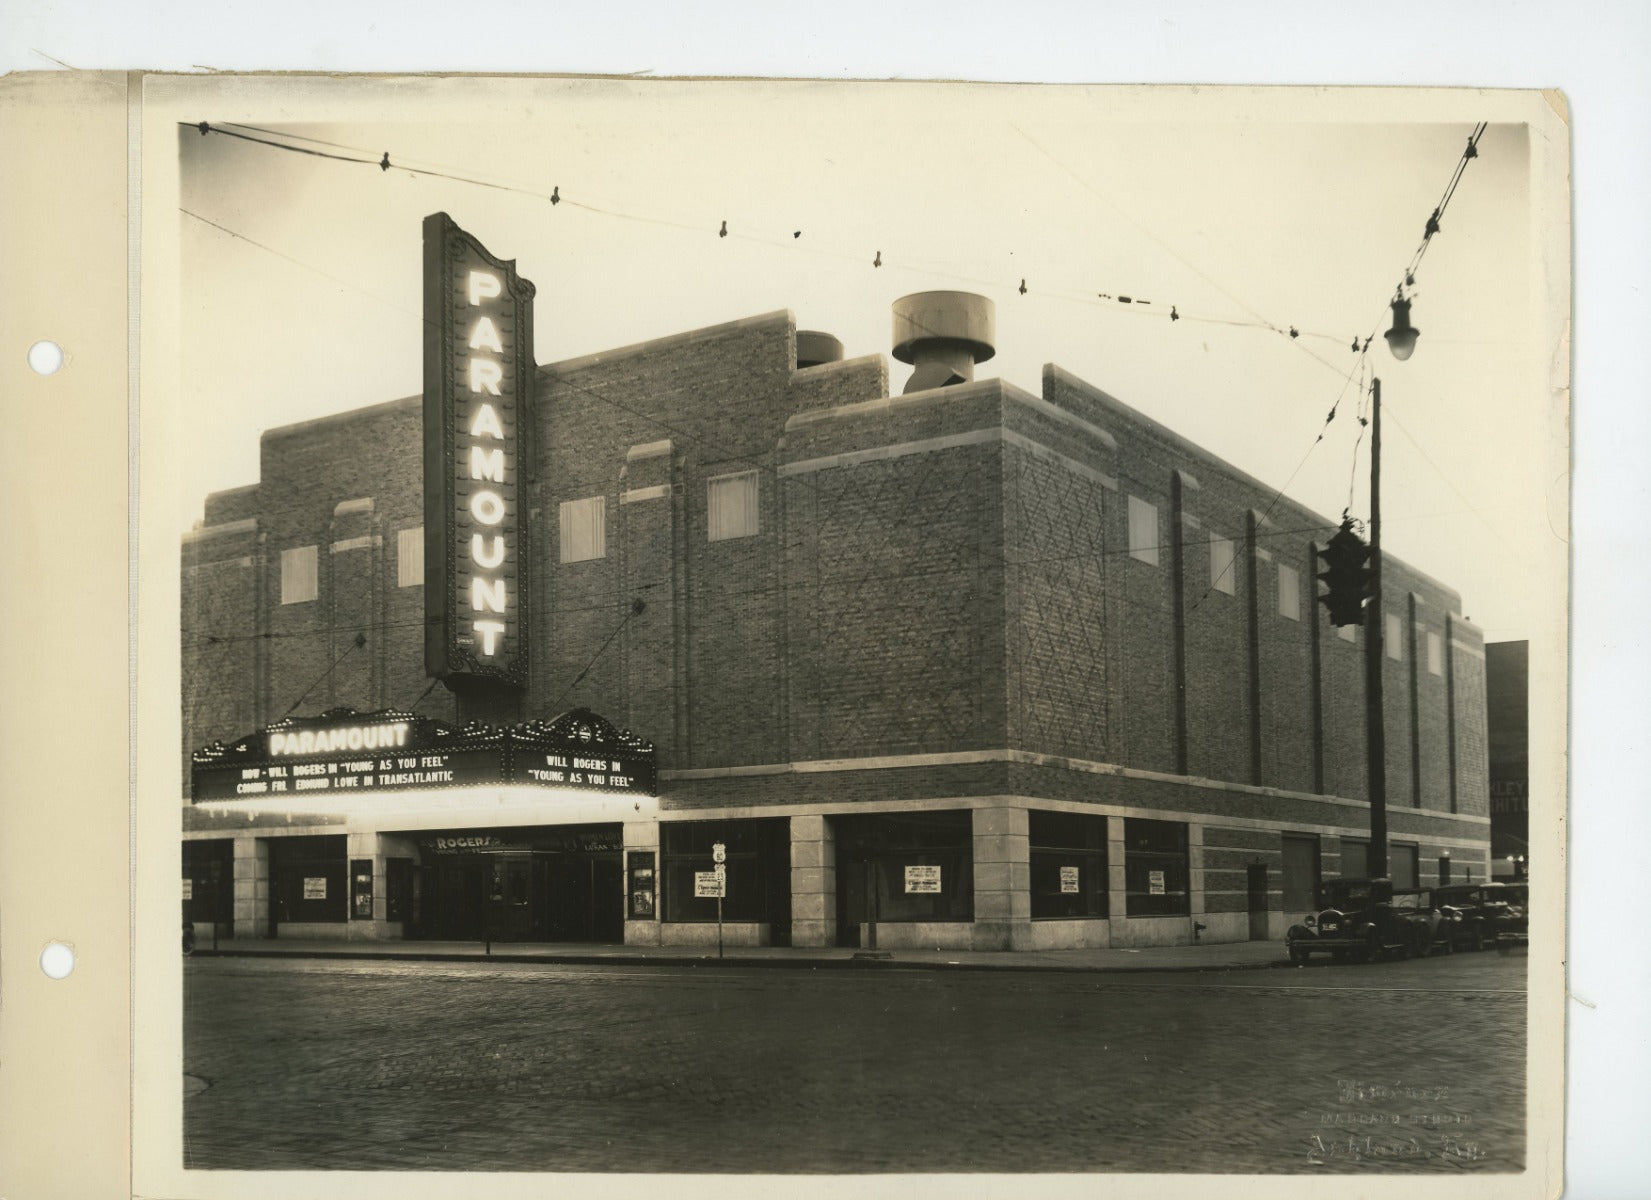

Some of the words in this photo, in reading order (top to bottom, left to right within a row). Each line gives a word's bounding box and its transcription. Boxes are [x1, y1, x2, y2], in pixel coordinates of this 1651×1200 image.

[469, 270, 506, 657] PARAMOUNT
[270, 723, 408, 755] PARAMOUNT
[268, 766, 288, 778] WILL
[293, 763, 326, 777] ROGERS
[328, 763, 338, 774] IN
[340, 760, 374, 773] "YOUNG
[380, 759, 392, 770] AS
[398, 758, 416, 769] YOU
[421, 755, 448, 768] FEEL"
[546, 755, 568, 767] WILL
[573, 757, 607, 771] ROGERS
[612, 761, 621, 772] IN
[236, 782, 267, 794] COMING
[295, 778, 329, 790] EDMUND
[334, 776, 358, 788] LOWE
[364, 775, 373, 786] IN
[379, 770, 453, 785] TRANSATLANTIC
[528, 769, 564, 782] "YOUNG
[569, 772, 582, 783] AS
[587, 773, 605, 785] YOU
[610, 775, 634, 787] FEEL"
[436, 836, 491, 849] ROGERS
